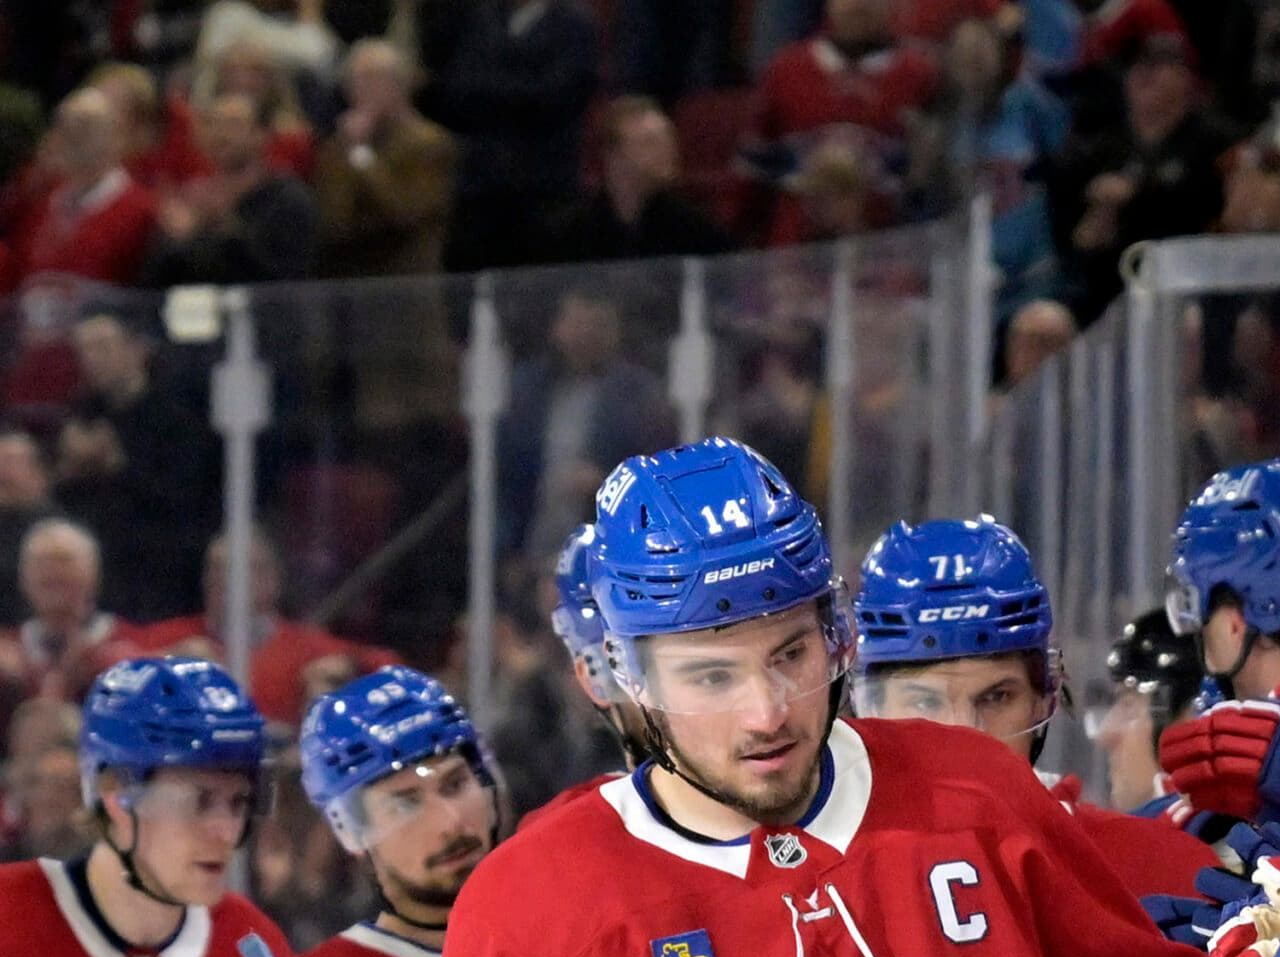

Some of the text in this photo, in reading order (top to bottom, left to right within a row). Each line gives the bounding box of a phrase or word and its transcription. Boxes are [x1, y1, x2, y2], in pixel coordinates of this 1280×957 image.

[702, 500, 749, 535] 14
[704, 558, 775, 584] BAUER
[928, 554, 967, 580] 71
[918, 604, 989, 623] CCM
[928, 859, 989, 943] C
